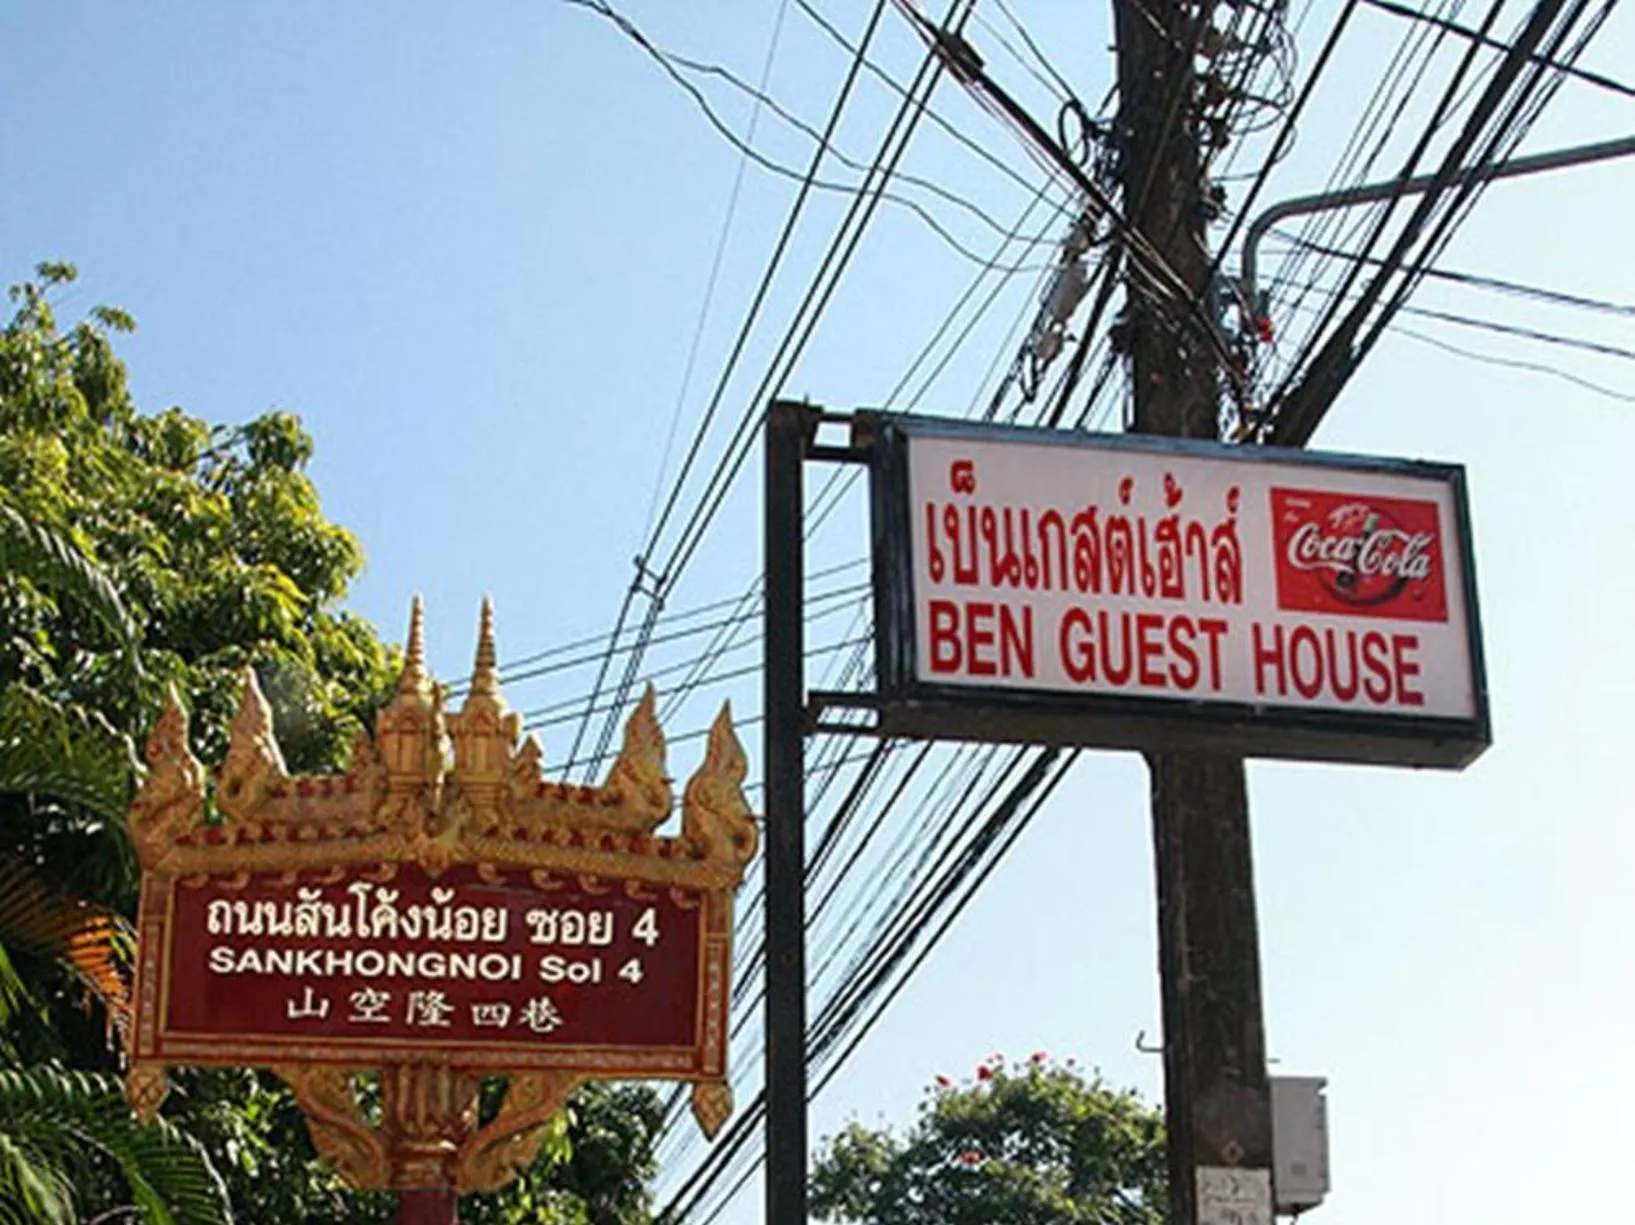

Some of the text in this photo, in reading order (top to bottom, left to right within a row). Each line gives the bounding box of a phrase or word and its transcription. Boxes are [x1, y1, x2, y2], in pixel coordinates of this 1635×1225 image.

[929, 600, 1424, 705] BEN GUEST HOUSE
[525, 909, 613, 945] ซอย
[632, 907, 659, 946] 4
[209, 946, 521, 980] SANKHONGNOI
[618, 957, 643, 983] 4
